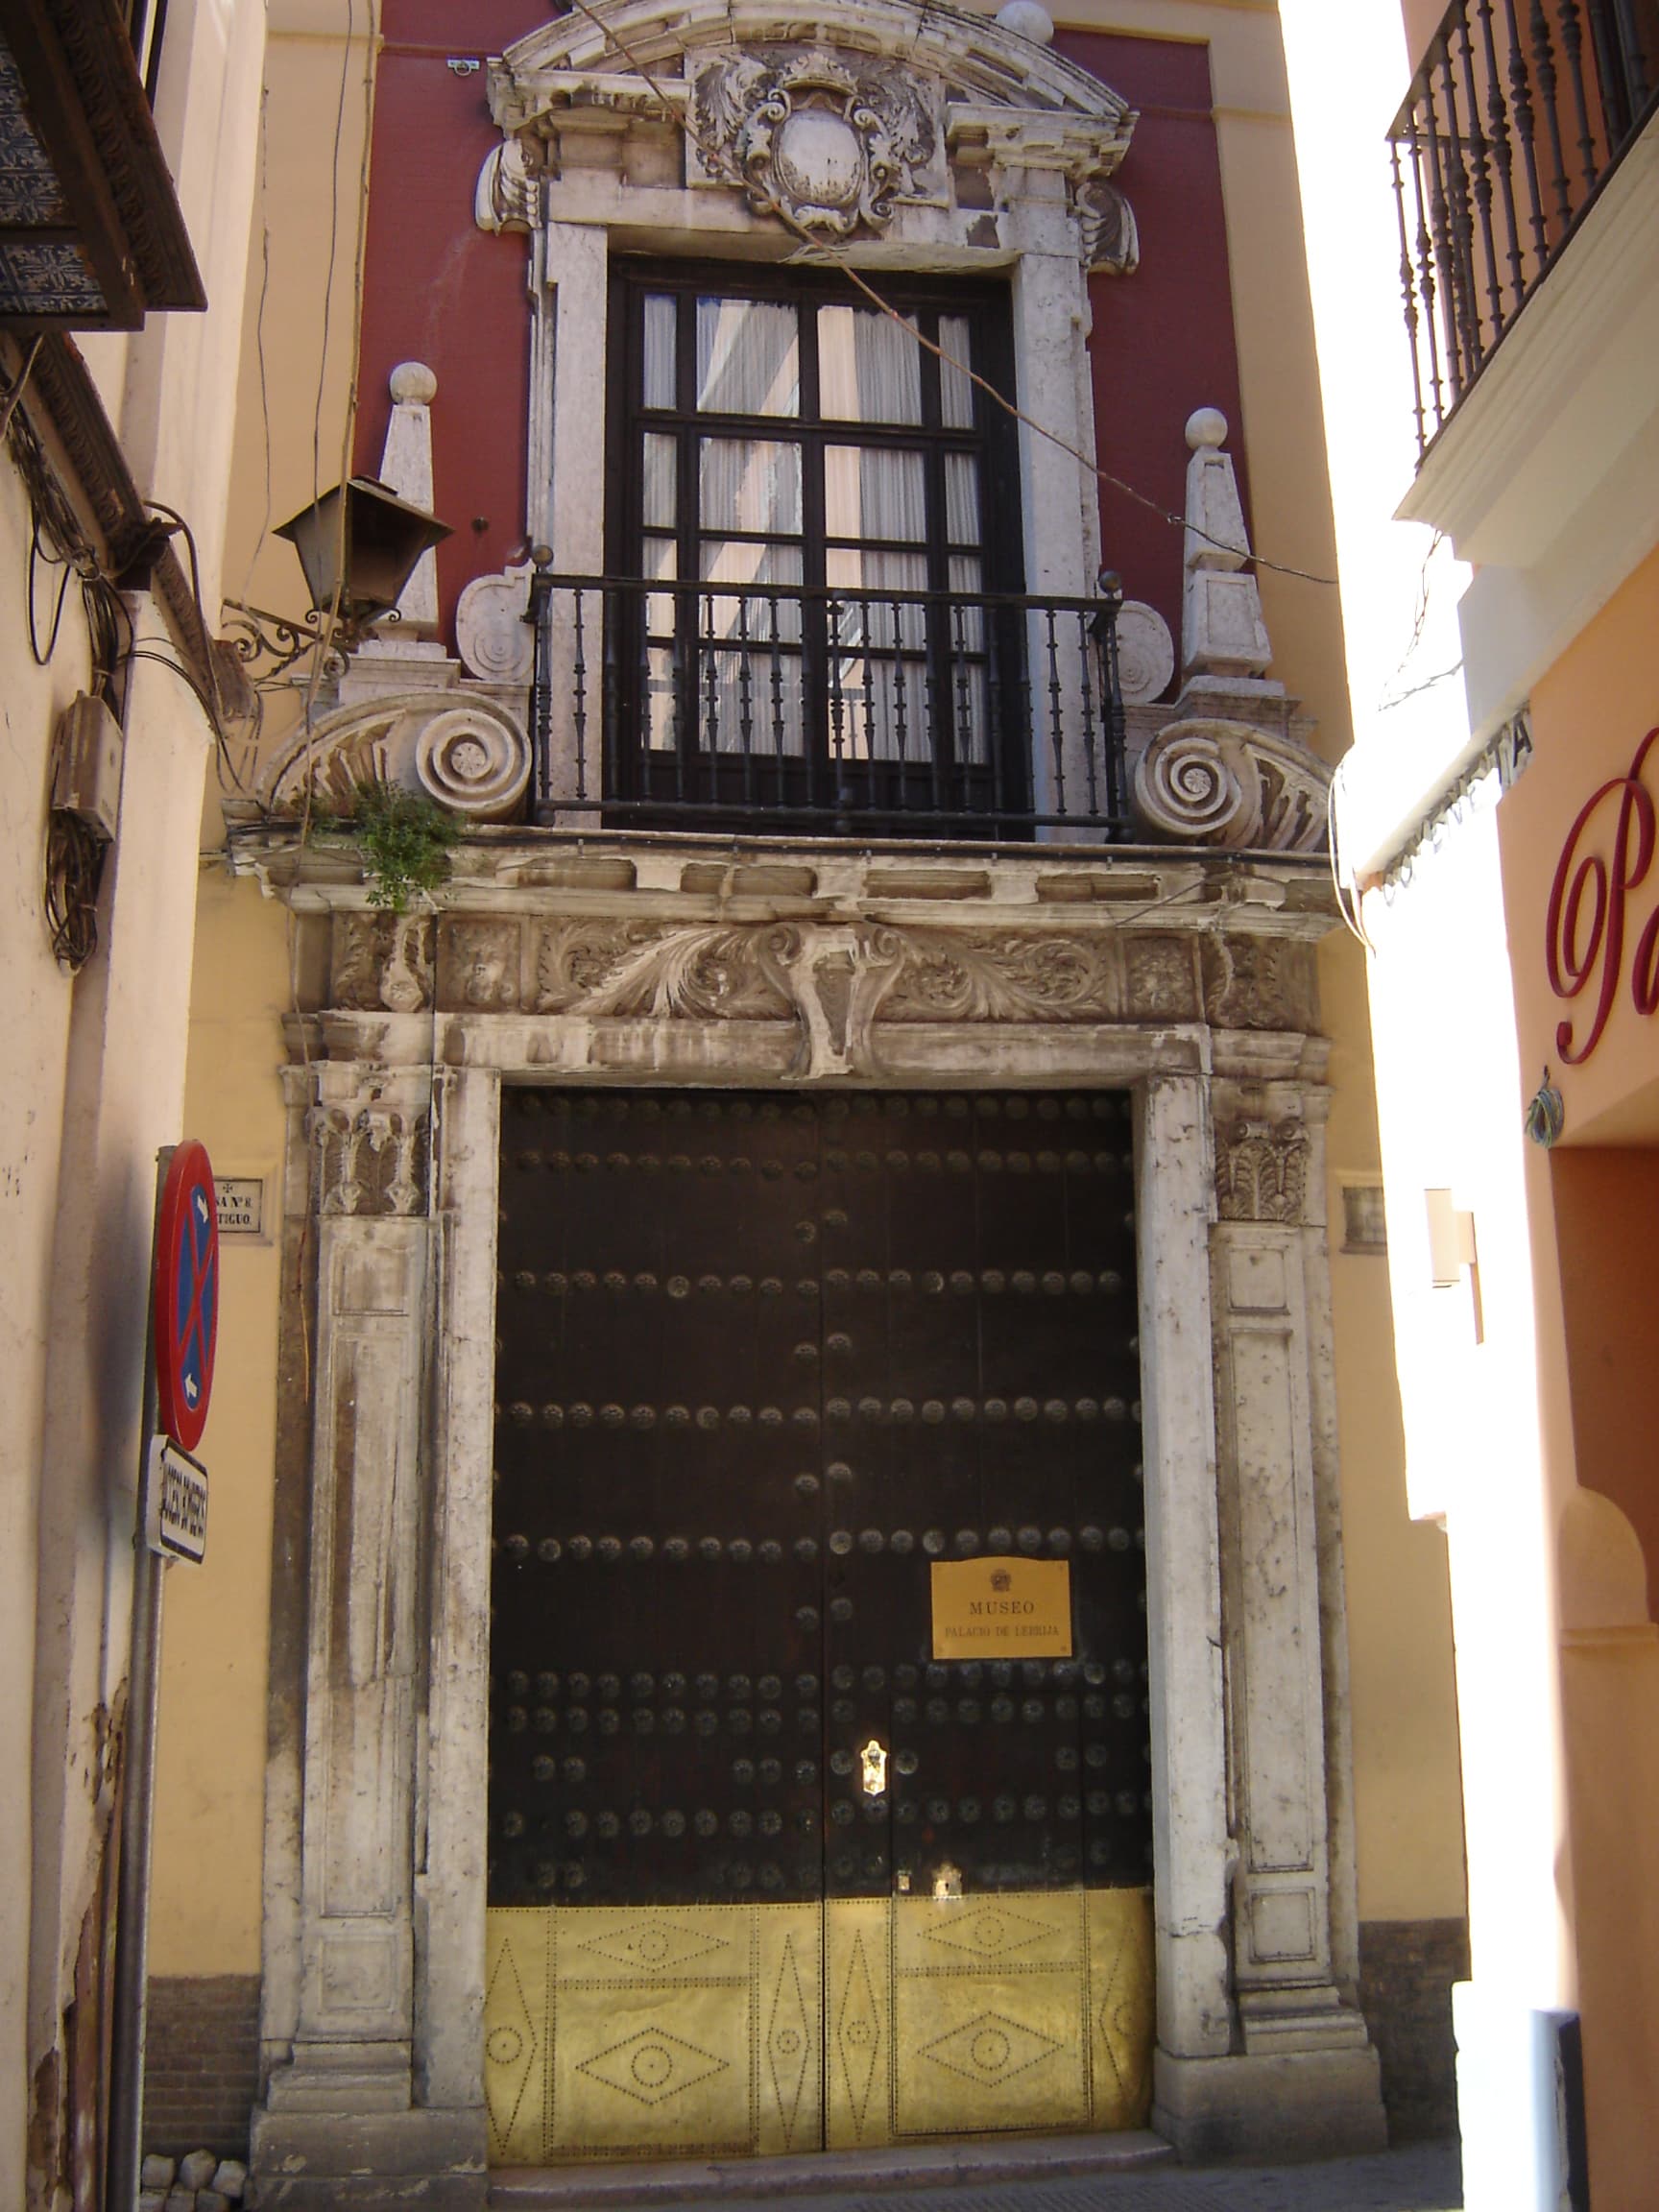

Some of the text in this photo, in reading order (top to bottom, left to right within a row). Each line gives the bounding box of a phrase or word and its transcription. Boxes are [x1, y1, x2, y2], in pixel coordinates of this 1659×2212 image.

[218, 1213, 251, 1225] TIGUO
[969, 1600, 1035, 1615] MUSEO
[945, 1626, 991, 1638] PALACIO
[996, 1626, 1009, 1637] DE
